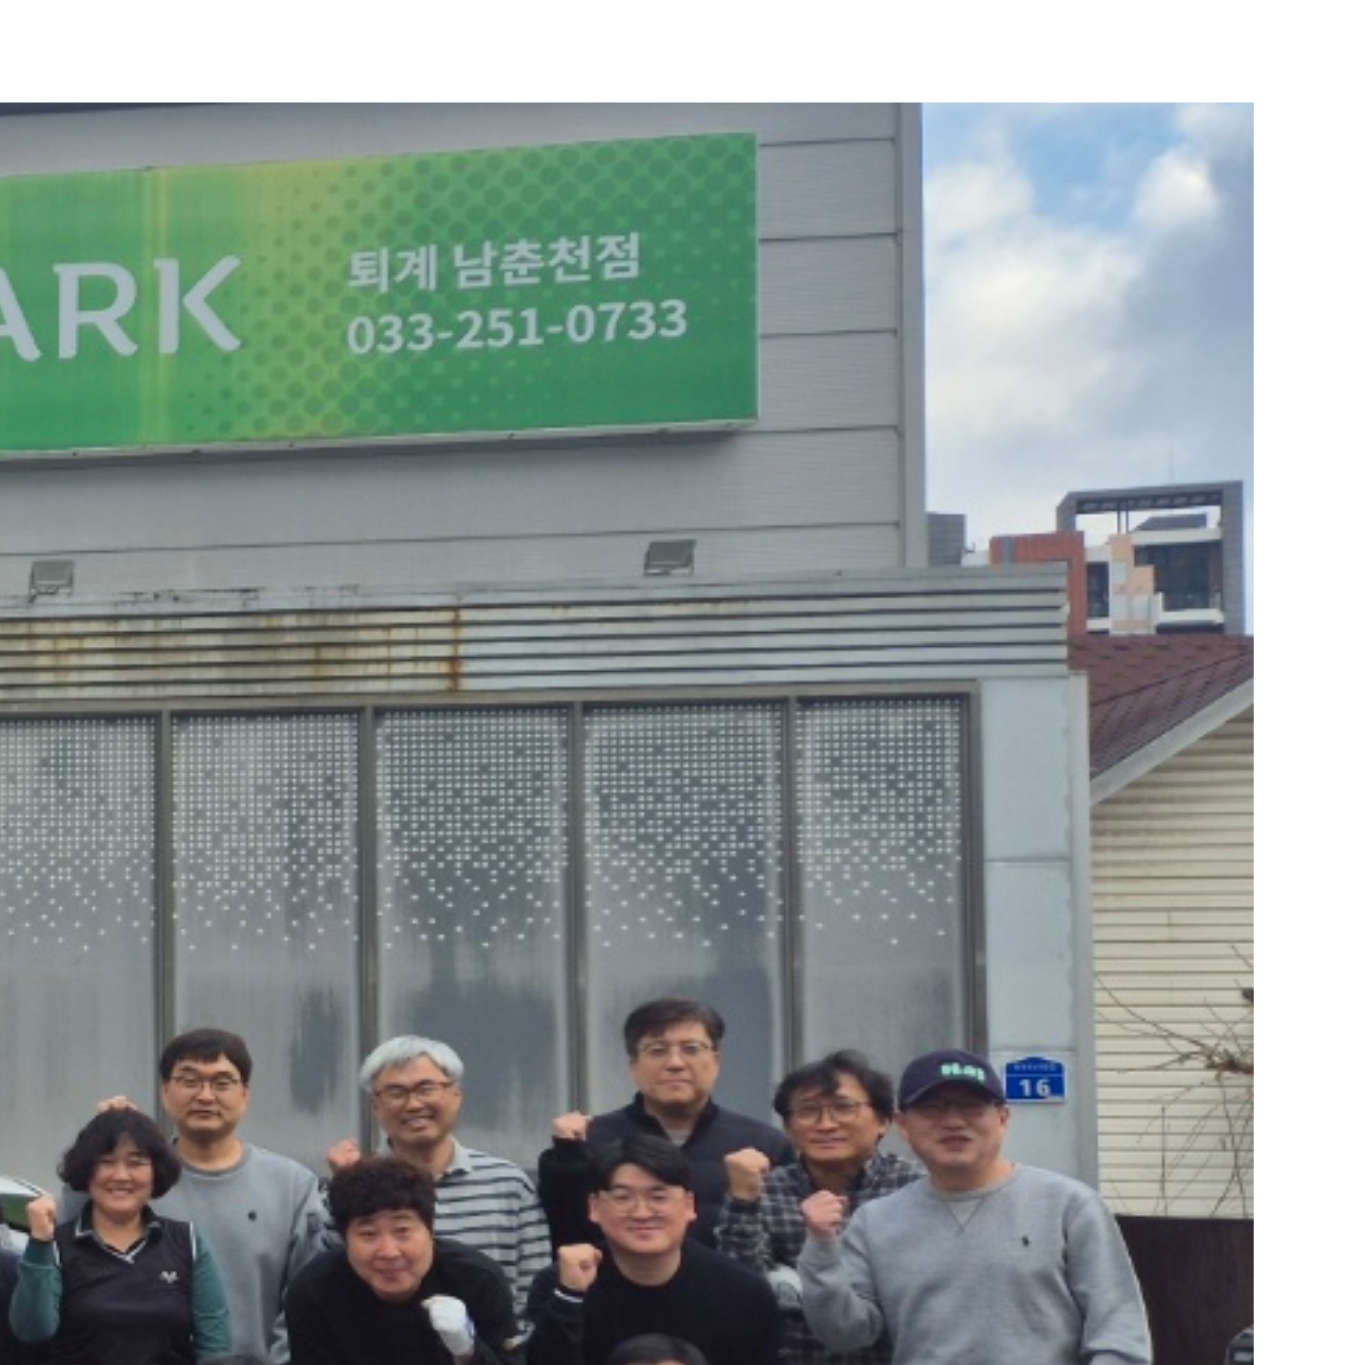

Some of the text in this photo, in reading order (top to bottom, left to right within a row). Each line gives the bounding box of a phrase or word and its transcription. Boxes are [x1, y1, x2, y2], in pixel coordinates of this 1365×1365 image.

[348, 232, 640, 293] 퇴계 남춘천점
[347, 299, 688, 353] 033-251-0733
[1020, 1077, 1051, 1097] 16
